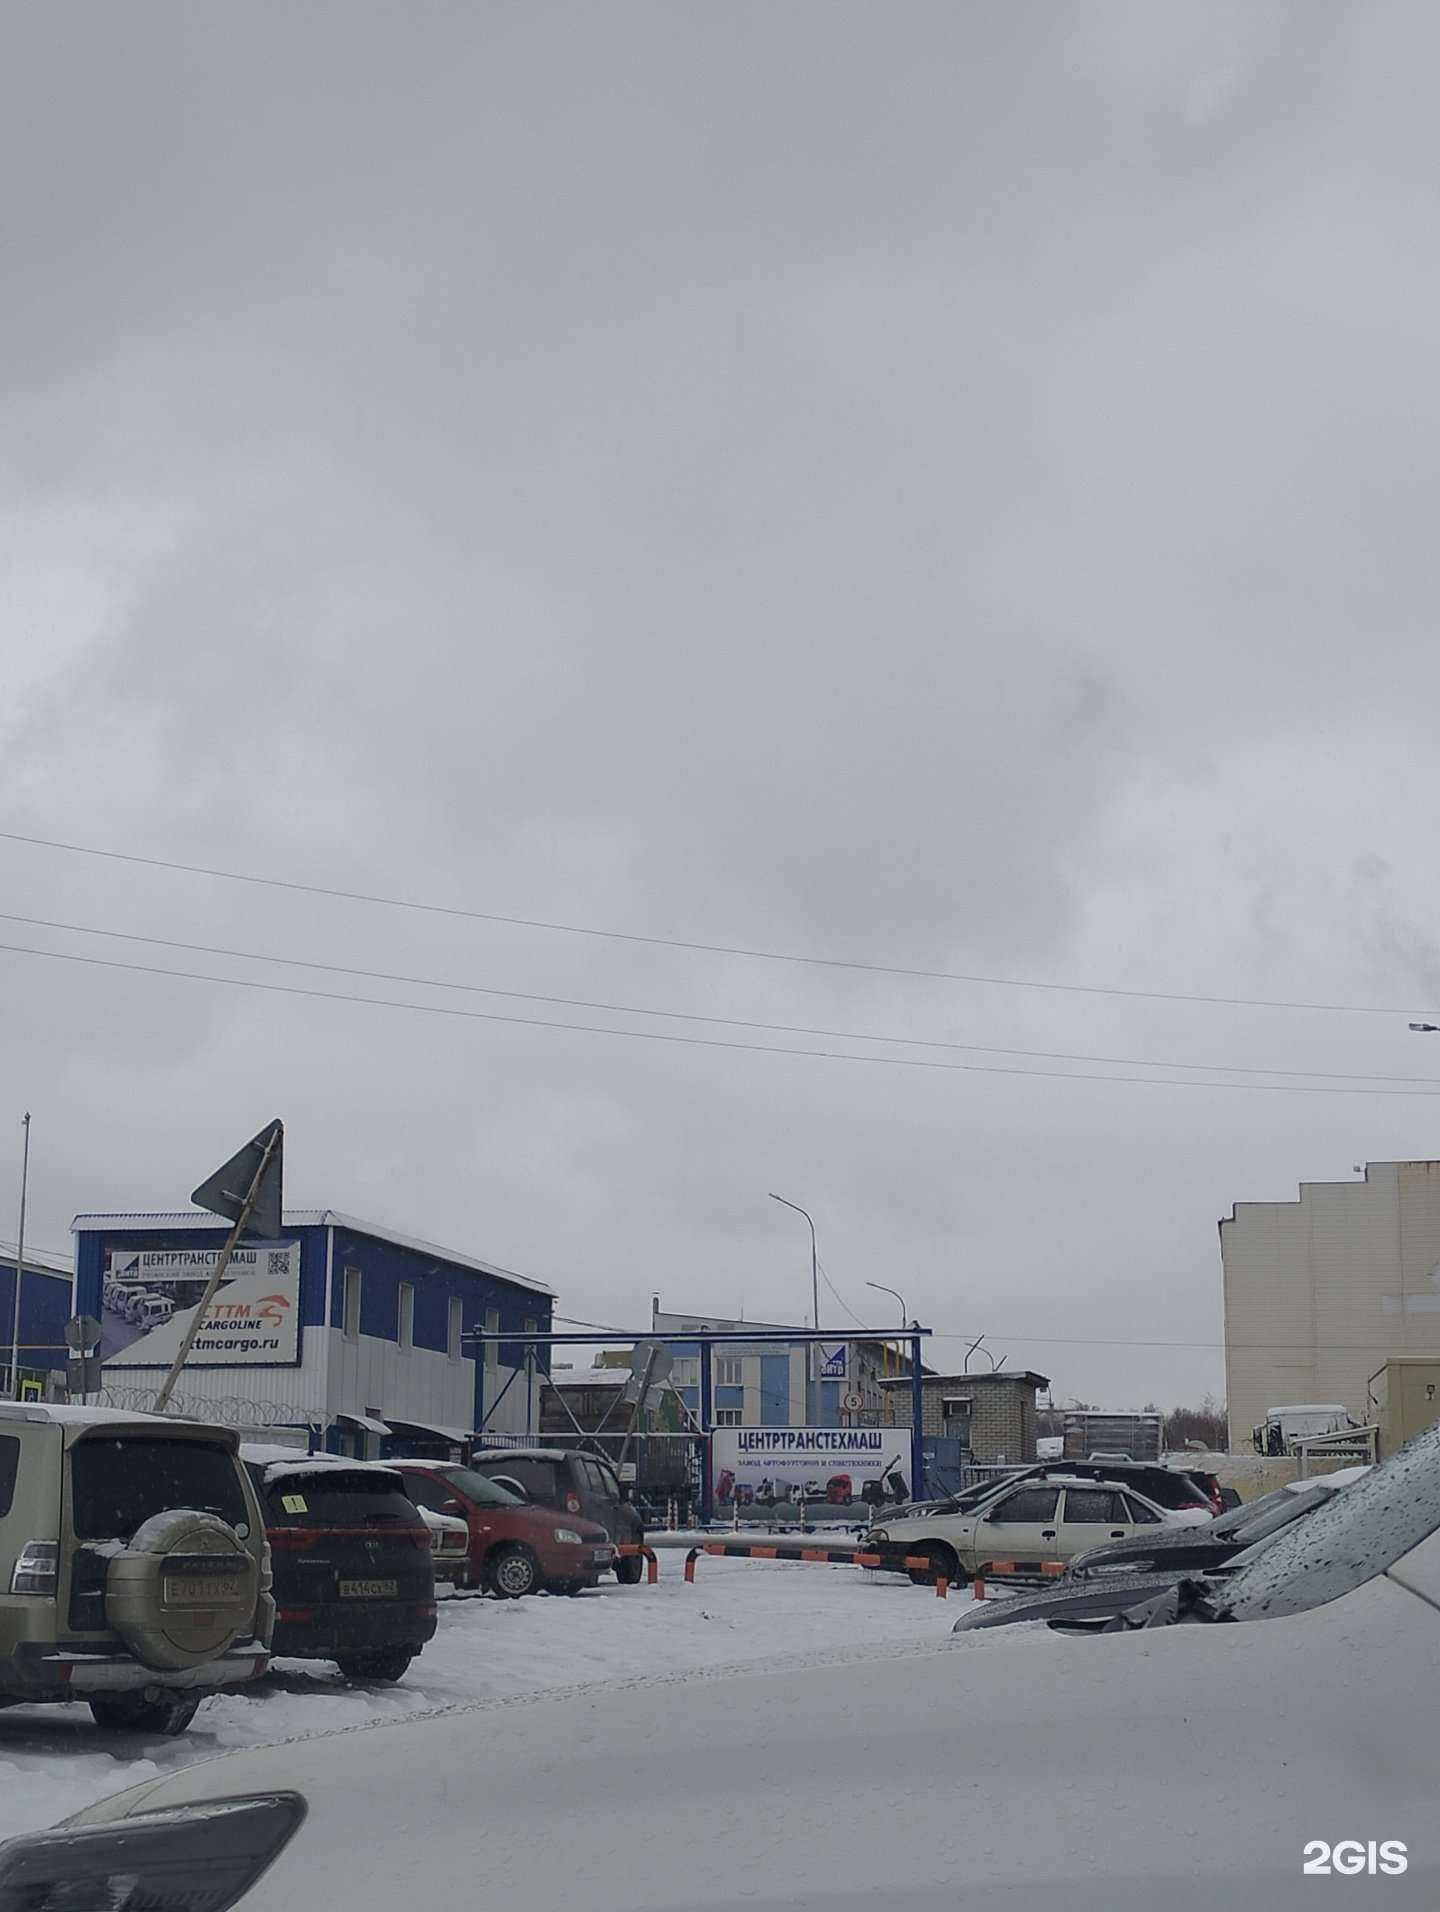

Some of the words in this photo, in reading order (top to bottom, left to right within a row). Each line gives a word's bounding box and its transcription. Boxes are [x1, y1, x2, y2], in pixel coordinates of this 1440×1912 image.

[143, 1252, 257, 1267] ЦЕНТРТРАНСТМАШ
[198, 1319, 264, 1330] CARGOLINE
[851, 1396, 858, 1407] 5
[737, 1431, 882, 1452] ЦЕНТРТРАНСТЕХМАШ
